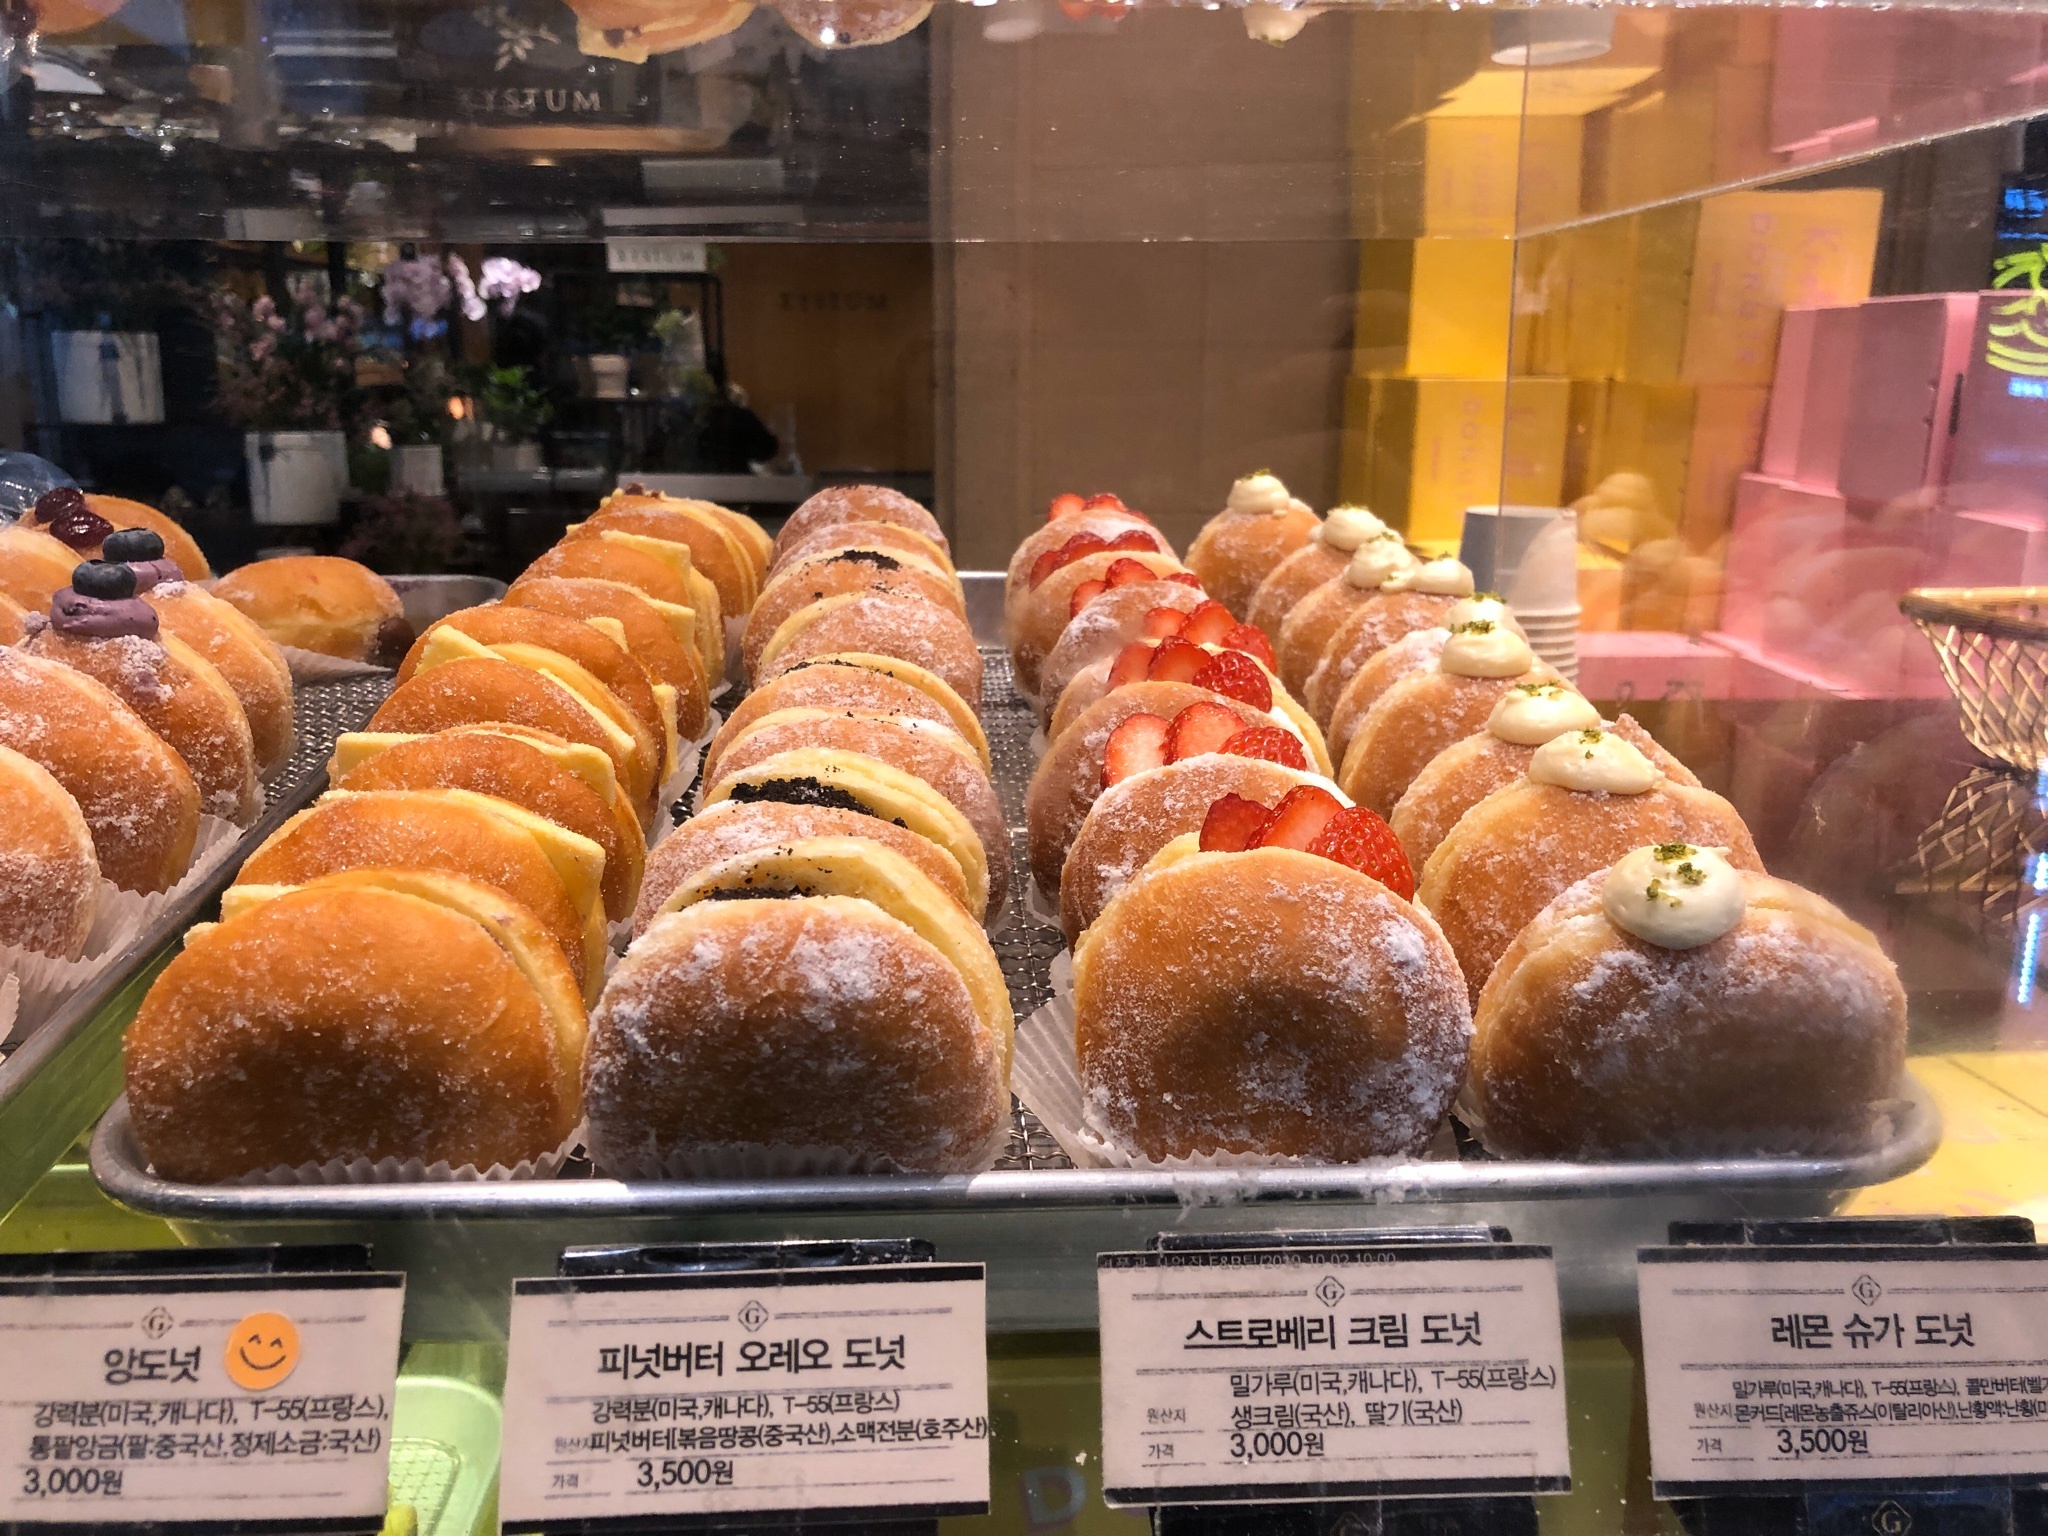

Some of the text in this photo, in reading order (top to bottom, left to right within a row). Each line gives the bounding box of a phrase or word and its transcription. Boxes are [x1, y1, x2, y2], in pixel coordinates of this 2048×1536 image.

[1184, 1311, 1483, 1351] 스트로베리 크림 도넛
[1771, 1312, 1976, 1349] 레몬 슈가 도넛
[104, 1346, 201, 1385] 앙도넛
[598, 1335, 906, 1380] 피넛버터 오레오 도넛
[1229, 1364, 1557, 1397] 밀가루(미국,캐나다), T-55(프랑스)
[592, 1389, 900, 1423] 강력분(미국,캐나다), T-55(프랑스)
[1146, 1406, 1187, 1425] 원산지
[1230, 1399, 1463, 1429] 생크림(국산), 딸기(국산)
[1148, 1443, 1175, 1459] 가격
[1229, 1433, 1326, 1463] 3,000원
[1698, 1438, 1722, 1453] 가격
[1777, 1429, 1869, 1458] 3,500원
[23, 1468, 123, 1497] 3,000원
[552, 1473, 579, 1489] 가격
[637, 1459, 735, 1491] 3,500원
